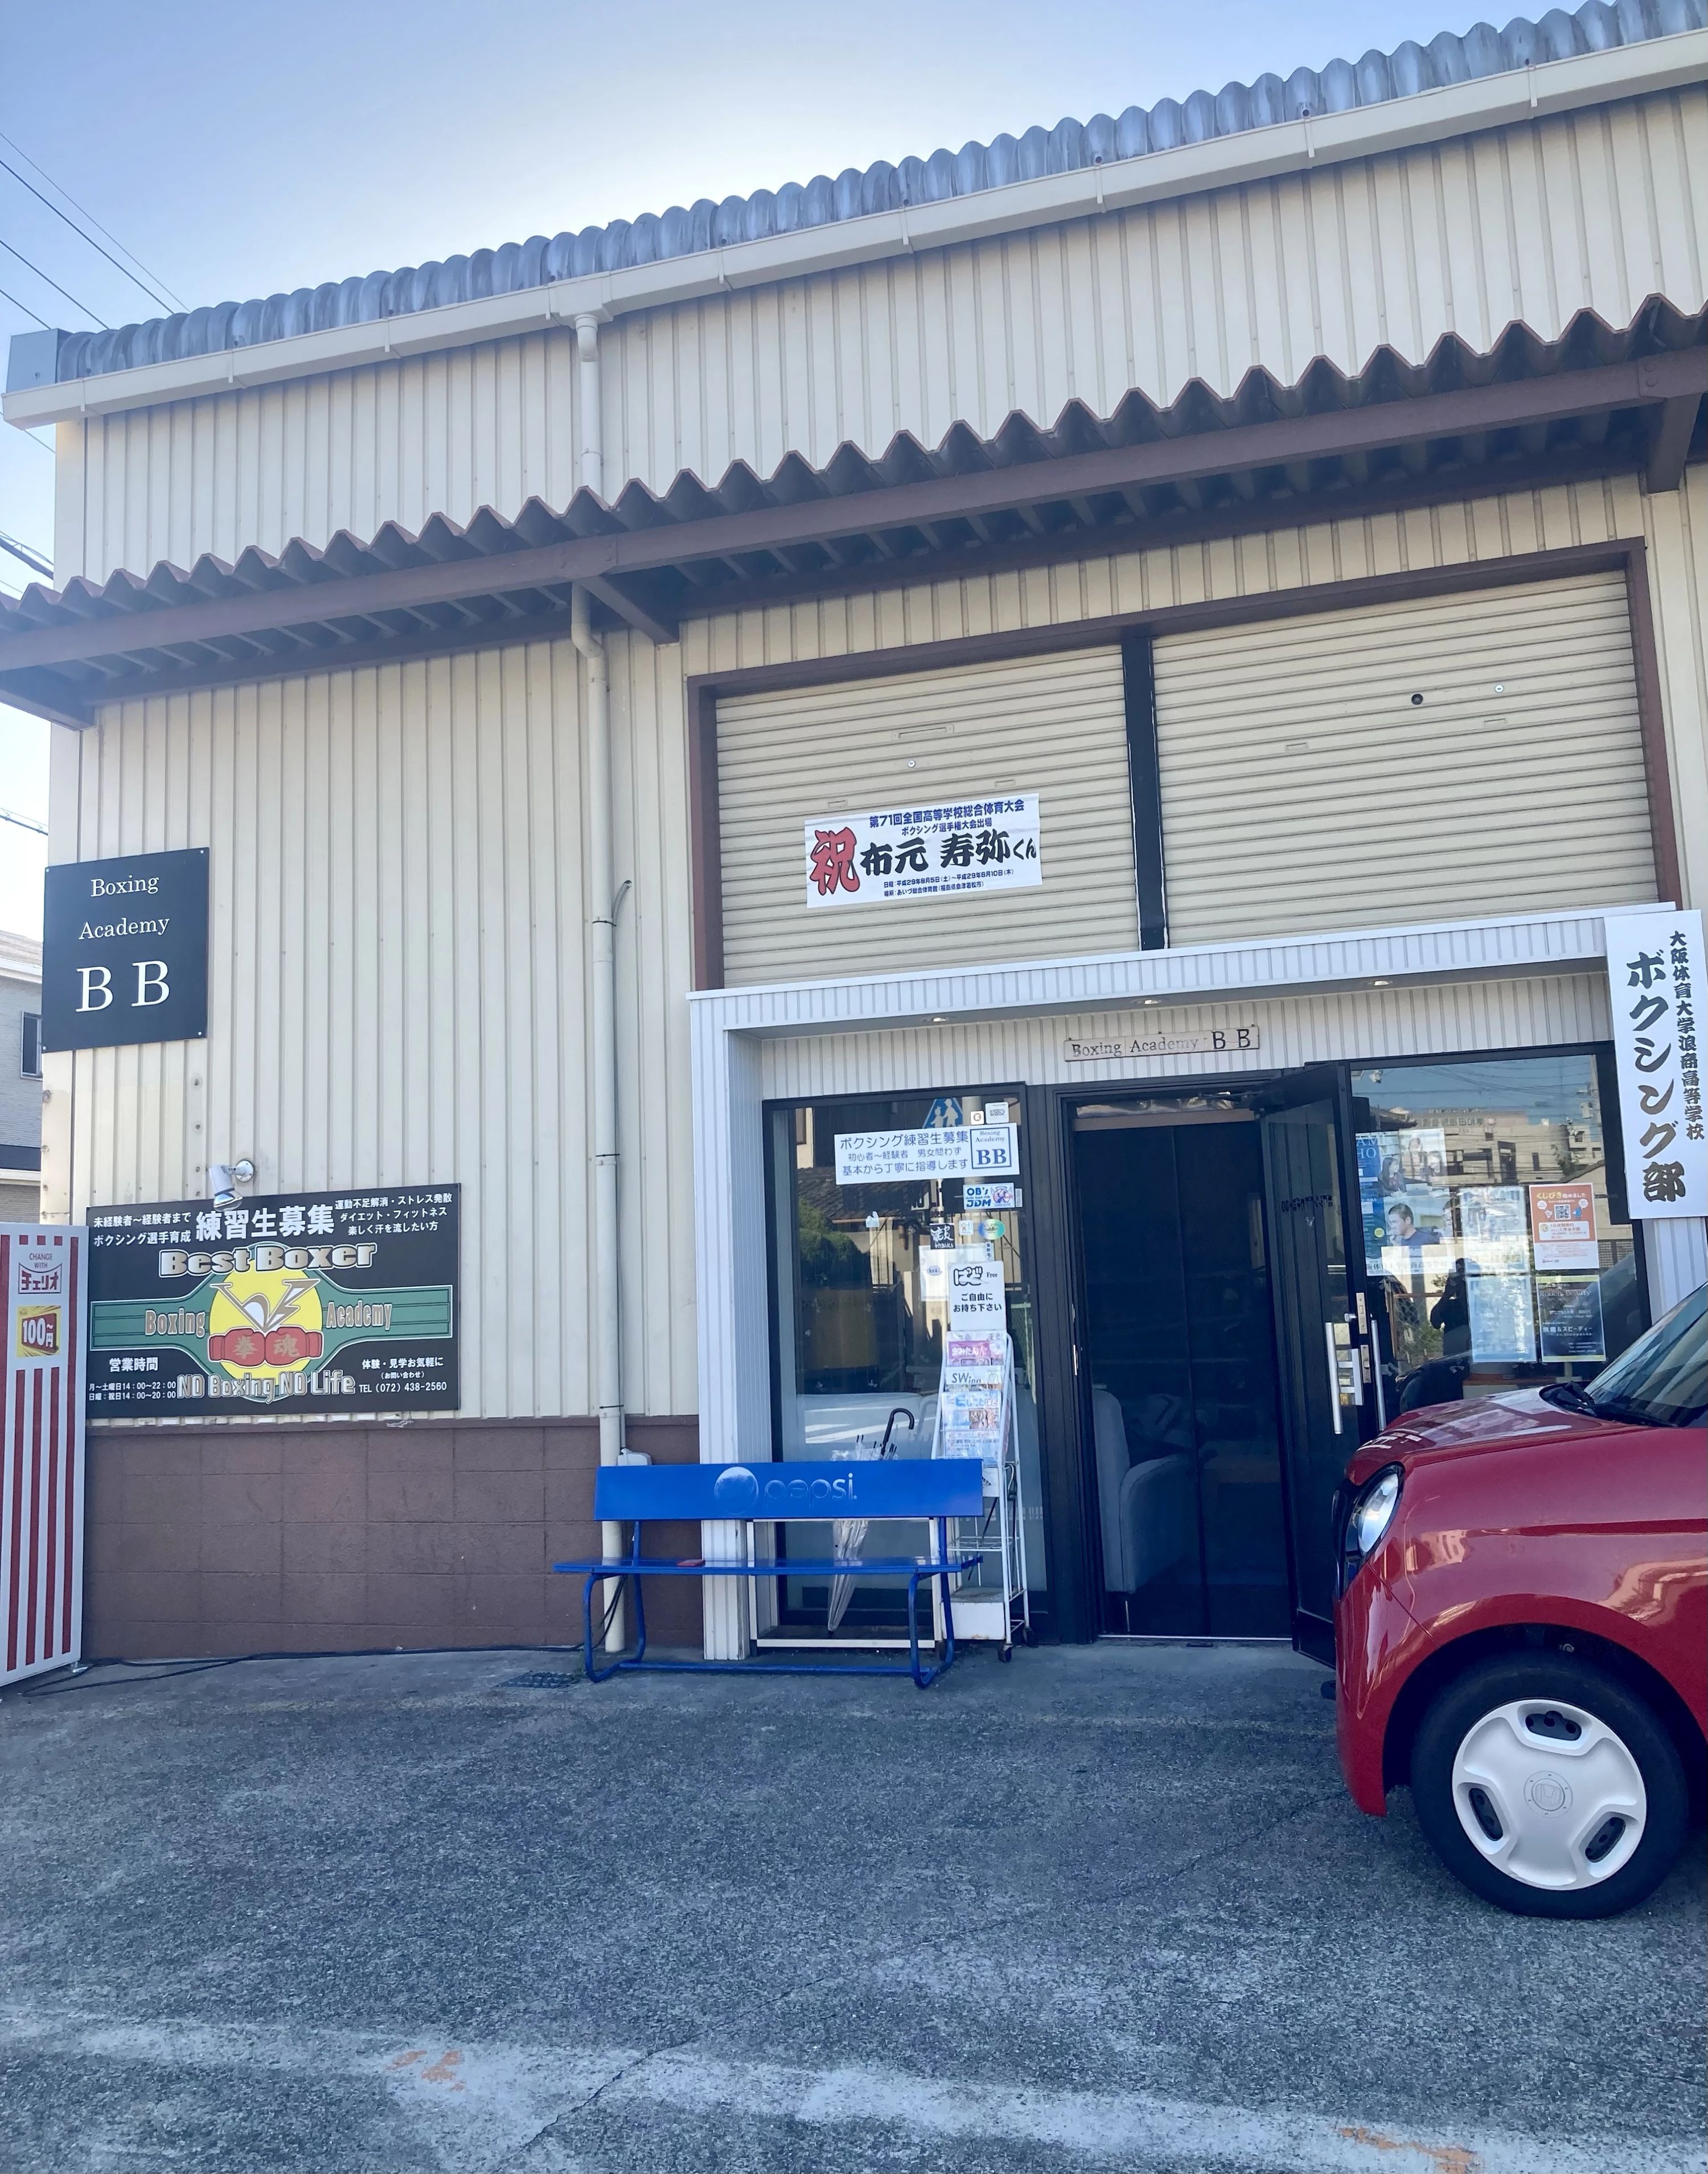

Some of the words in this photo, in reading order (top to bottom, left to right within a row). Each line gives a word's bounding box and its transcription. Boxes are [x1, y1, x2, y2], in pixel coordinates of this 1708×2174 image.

[869, 799, 1025, 828] 第71回全国高等学校総合体育大会
[901, 817, 992, 836] ボクシング選手権大会出場
[809, 826, 860, 896] 祝
[91, 875, 159, 897] Boxing
[78, 917, 170, 940] Academy
[1669, 930, 1705, 1141] 大阪体育大学浪商高等学校
[1071, 1042, 1122, 1058] Boxing
[1130, 1037, 1198, 1053] Academy
[1627, 949, 1686, 1203] ボクシング部
[840, 1130, 969, 1150] ボクシング練習生募集
[917, 1147, 962, 1158] 男女問わず
[976, 1148, 1007, 1165] BB
[842, 1159, 968, 1176] 基本から丁寧に指導します
[335, 1192, 453, 1211] 運動不足解消・ストレス発散
[966, 1199, 991, 1207] JDM
[93, 1212, 192, 1228] 未経験者～経験者まで
[196, 1203, 335, 1242] 練習生募集
[340, 1207, 447, 1223] ダイエット・フィットネス
[348, 1221, 438, 1236] 楽しく汗を流したい方
[93, 1230, 192, 1247] ボクシング選手育成
[29, 1253, 53, 1261] CHANGE
[159, 1247, 251, 1278] Best
[255, 1242, 377, 1271] Boxer
[21, 1269, 59, 1291] チェリオ
[961, 1293, 993, 1302] ご自由に
[953, 1303, 1002, 1312] お持ち下さい
[145, 1308, 205, 1338] Boxing
[325, 1299, 393, 1332] Academy
[109, 1357, 158, 1373] 営業時間
[362, 1356, 444, 1369] 体験・見学お気軽に
[176, 1373, 205, 1399] NO
[208, 1372, 276, 1405] Boxing
[279, 1370, 307, 1396] NO
[311, 1369, 356, 1396] Life
[359, 1384, 372, 1393] TEL
[404, 1381, 447, 1392] 438-2560
